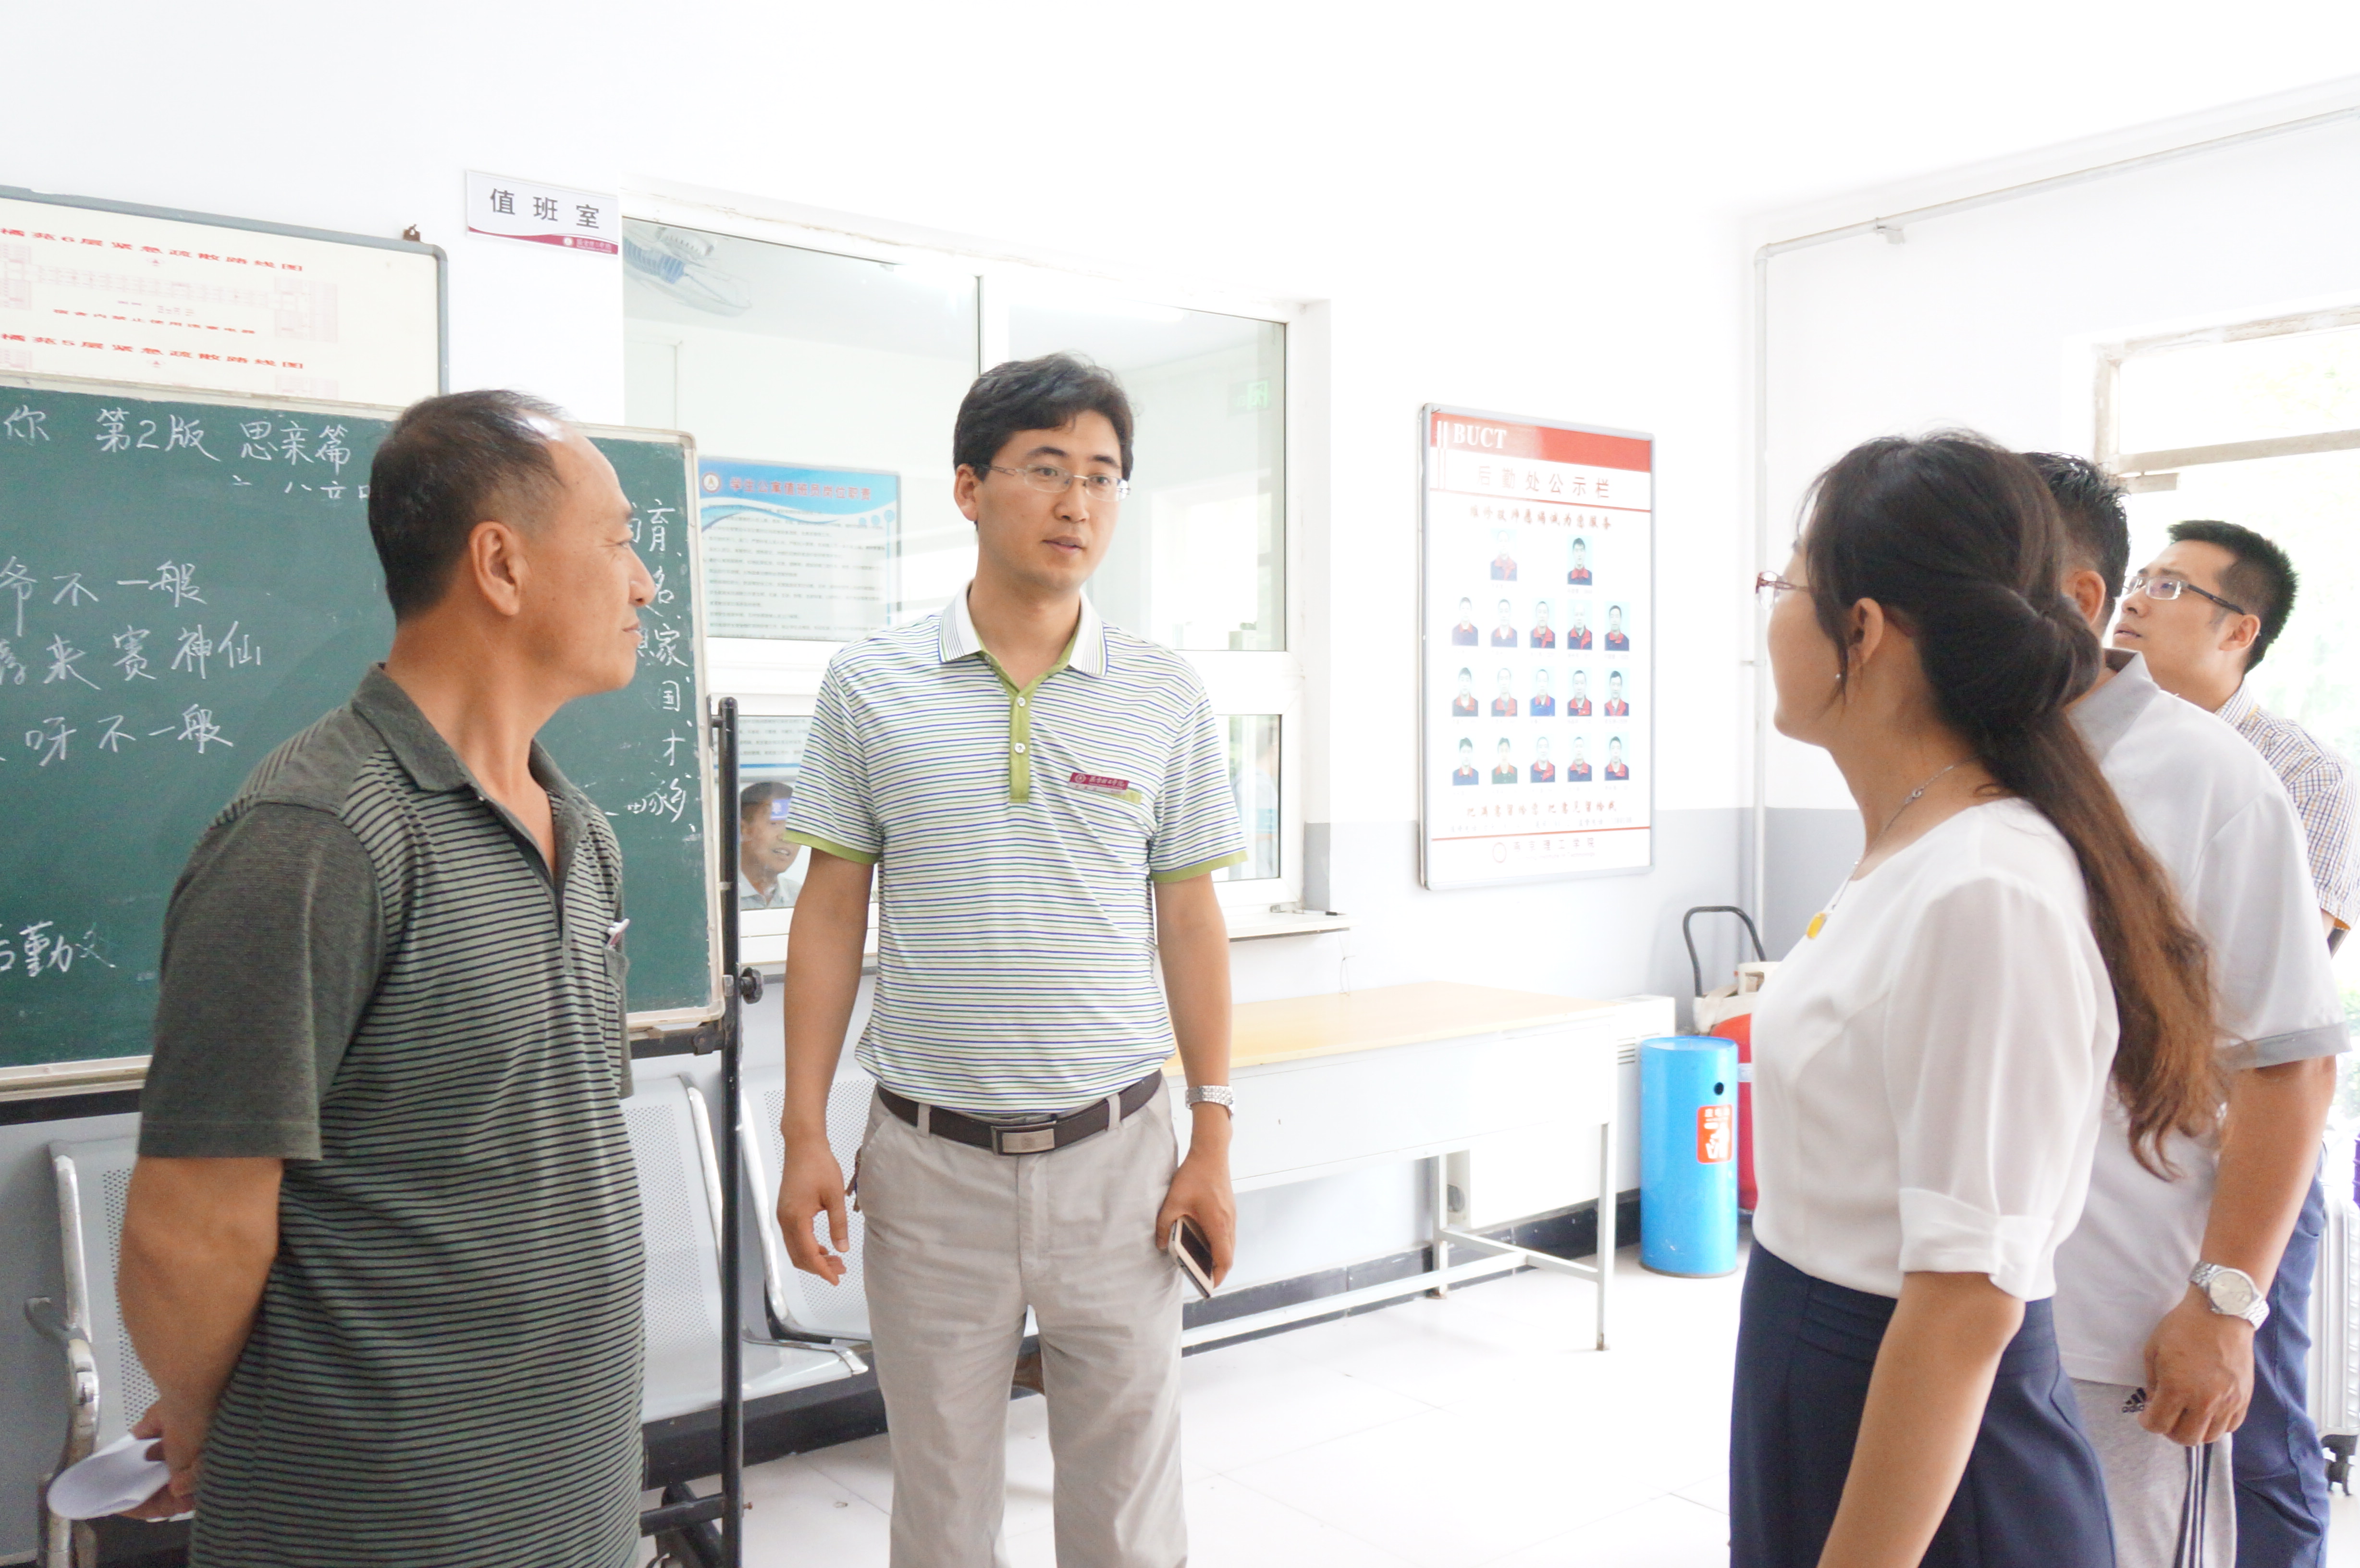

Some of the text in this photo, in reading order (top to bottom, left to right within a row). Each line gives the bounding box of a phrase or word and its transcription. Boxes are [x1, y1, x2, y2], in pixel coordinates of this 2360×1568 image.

[490, 188, 600, 229] 值班室
[3, 404, 50, 445] 你
[96, 406, 221, 462] 第2版
[1452, 423, 1507, 449] BUCT
[730, 477, 871, 501] 学生公寓值班员岗位职责
[1478, 465, 1610, 498] 后勤处公示栏
